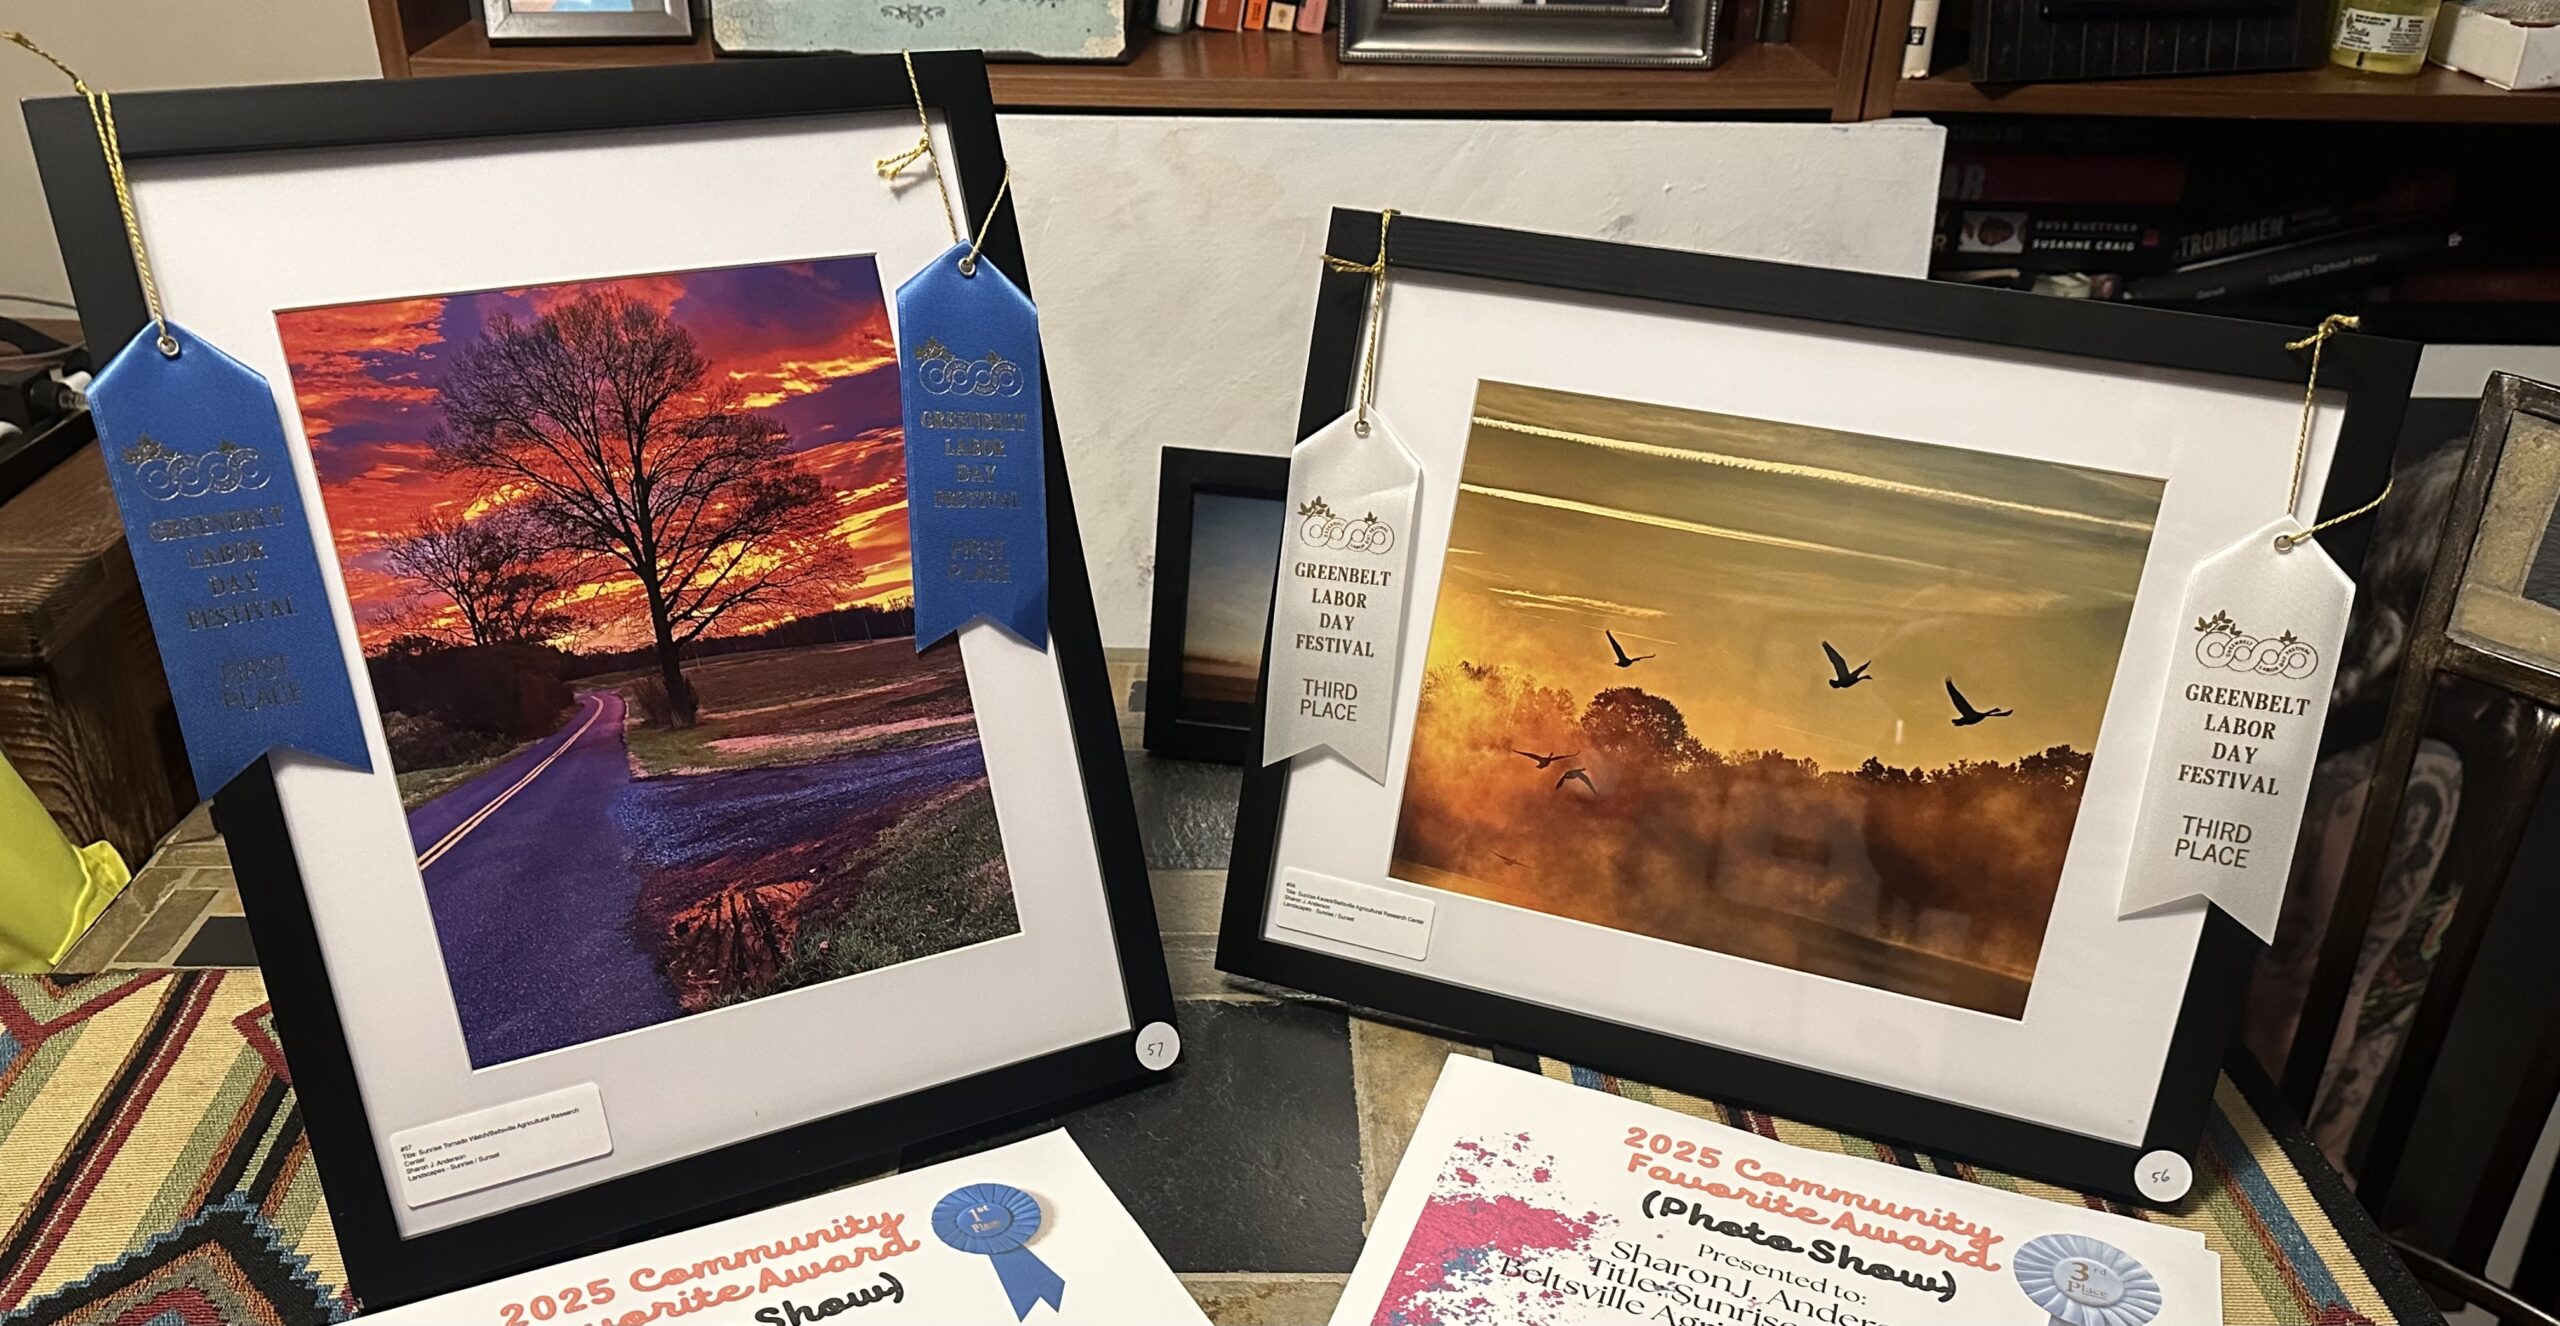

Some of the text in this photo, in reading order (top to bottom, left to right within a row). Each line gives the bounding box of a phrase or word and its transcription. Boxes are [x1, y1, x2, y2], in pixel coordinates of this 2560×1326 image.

[2032, 238, 2136, 252] SUSANNE CRAIG
[920, 410, 1028, 432] GREENBELT
[944, 438, 1007, 458] LABOR
[957, 464, 996, 483] DAY
[149, 506, 284, 542] GREENBELT
[187, 540, 268, 569] LABOR
[951, 539, 1006, 560] FIRST
[208, 570, 258, 597] DAY
[948, 563, 1012, 584] PLACE
[1294, 561, 1392, 587] GREENBELT
[1311, 588, 1367, 609] LABOR
[187, 597, 299, 632] FESTIVAL
[1319, 613, 1355, 631] DAY
[1295, 633, 1375, 658] FESTIVAL
[220, 656, 288, 686] FIRST
[223, 680, 301, 711] PLACE
[1303, 678, 1358, 700] THIRD
[2185, 683, 2311, 716] GREENBELT
[1300, 699, 1358, 722] PLACE
[2204, 713, 2276, 740] LABOR
[2211, 742, 2259, 764] DAY
[2177, 764, 2279, 796] FESTIVAL
[2183, 814, 2252, 844] THIRD
[2174, 838, 2250, 869] PLACE
[1147, 1041, 1164, 1057] 57
[418, 1145, 443, 1156] Sunrise
[443, 1138, 468, 1149] Tornado
[517, 1115, 550, 1129] Agricultural
[551, 1108, 579, 1120] Research
[404, 1157, 425, 1167] Center
[406, 1164, 429, 1174] Sharon
[437, 1154, 467, 1166] Anderson
[408, 1167, 445, 1182] Landscapes
[450, 1160, 474, 1170] Sunrise
[478, 1152, 500, 1163] Sunset
[1623, 1126, 2004, 1248] 2025 Community
[2152, 1169, 2171, 1183] 56
[968, 1204, 990, 1222] 1st
[1627, 1152, 2002, 1272] Favorite Award
[1642, 1189, 1956, 1303] (Photo Show)
[500, 1211, 905, 1326] 2025 Community
[758, 1238, 920, 1293] Award
[1589, 1256, 1663, 1297] Title:
[1610, 1240, 1732, 1293] Sharon
[1698, 1243, 1867, 1306] Presented to:
[2070, 1261, 2107, 1282] 3rd
[755, 1272, 904, 1326] Show)
[1499, 1256, 1646, 1316] Beltsville
[2066, 1280, 2109, 1298] Place
